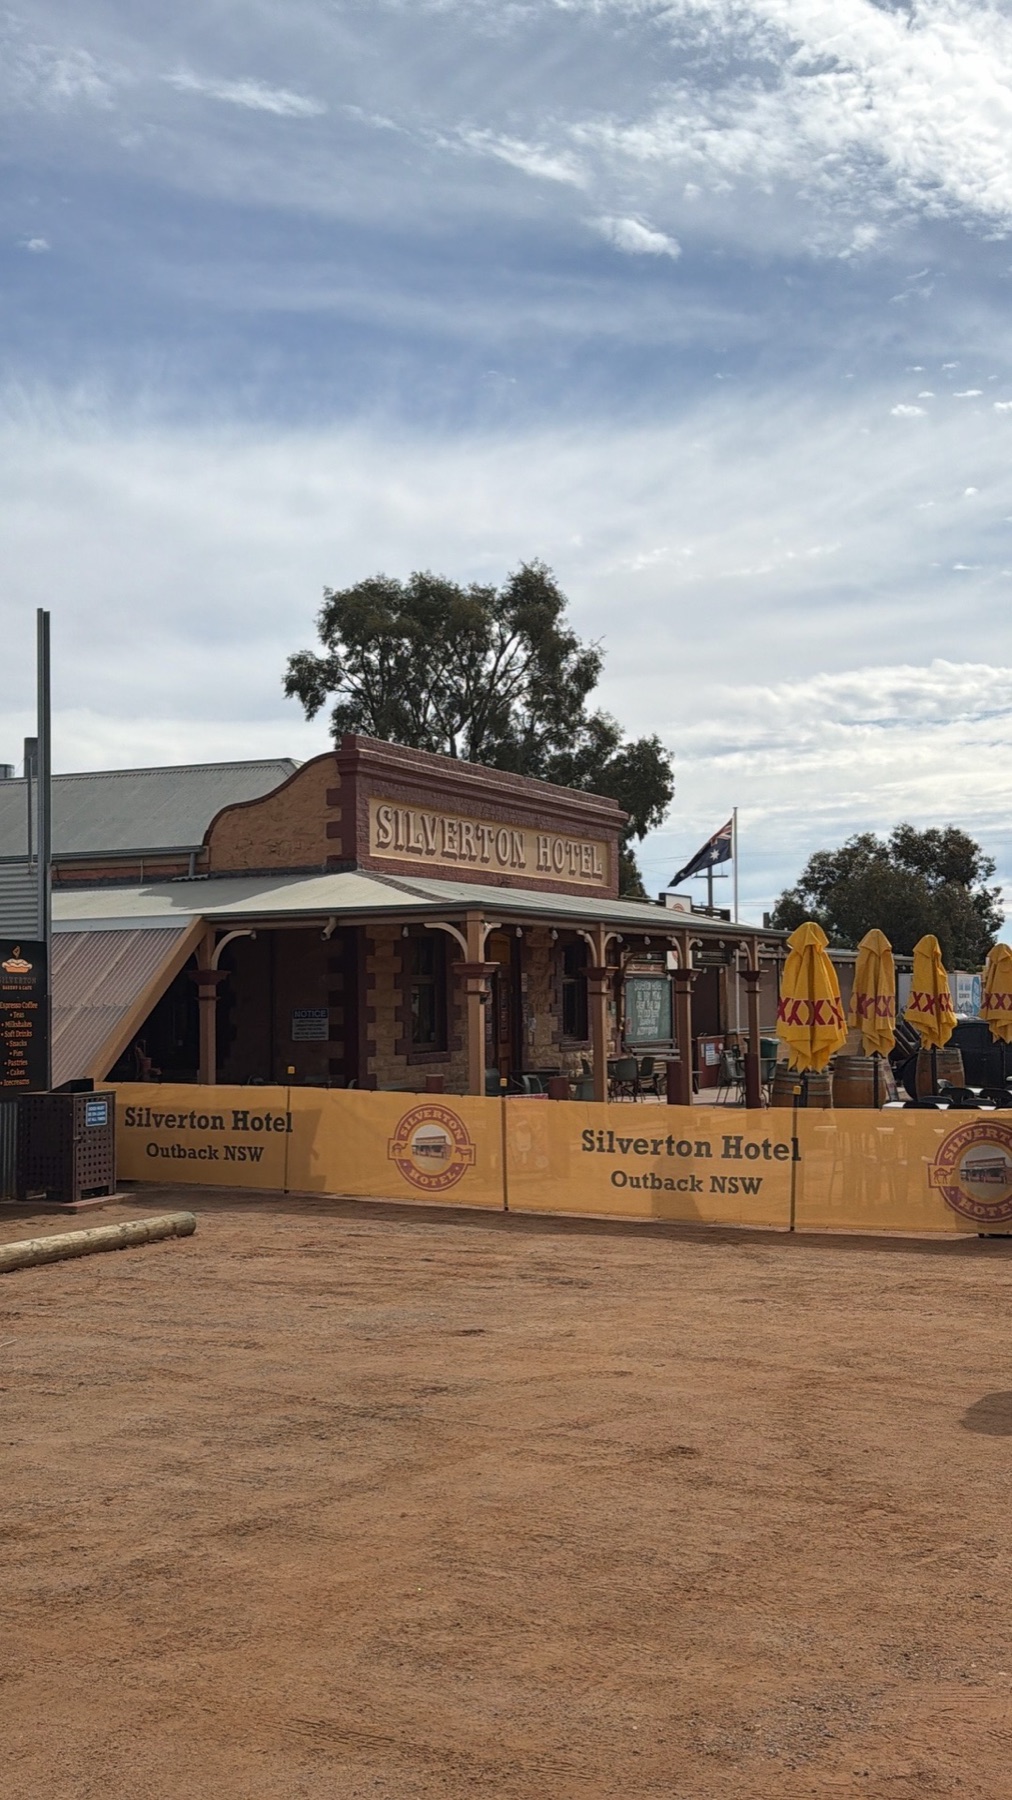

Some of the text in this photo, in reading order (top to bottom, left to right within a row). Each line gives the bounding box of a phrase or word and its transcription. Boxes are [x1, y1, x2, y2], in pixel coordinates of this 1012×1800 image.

[376, 804, 603, 880] SILVERTON HOTEL
[0, 1001, 38, 1011] Espresso Coffee
[13, 1011, 25, 1019] Teas
[294, 1010, 327, 1018] NOTICE
[4, 1020, 32, 1028] Milkshakes
[4, 1030, 33, 1038] Soft Drinks
[9, 1039, 27, 1047] Snacks
[12, 1049, 24, 1057] Pies
[7, 1058, 28, 1066] Pastries
[10, 1068, 25, 1076] Cakes
[3, 1078, 30, 1086] Icecreams
[124, 1106, 293, 1133] Silverton Hotel
[400, 1109, 464, 1140] SILVERTON
[581, 1128, 802, 1162] Silverton Hotel
[146, 1142, 264, 1162] Outback NSW
[409, 1169, 456, 1186] HOTEL
[610, 1170, 763, 1195] Outback NSW
[958, 1198, 1012, 1217] HOTE
